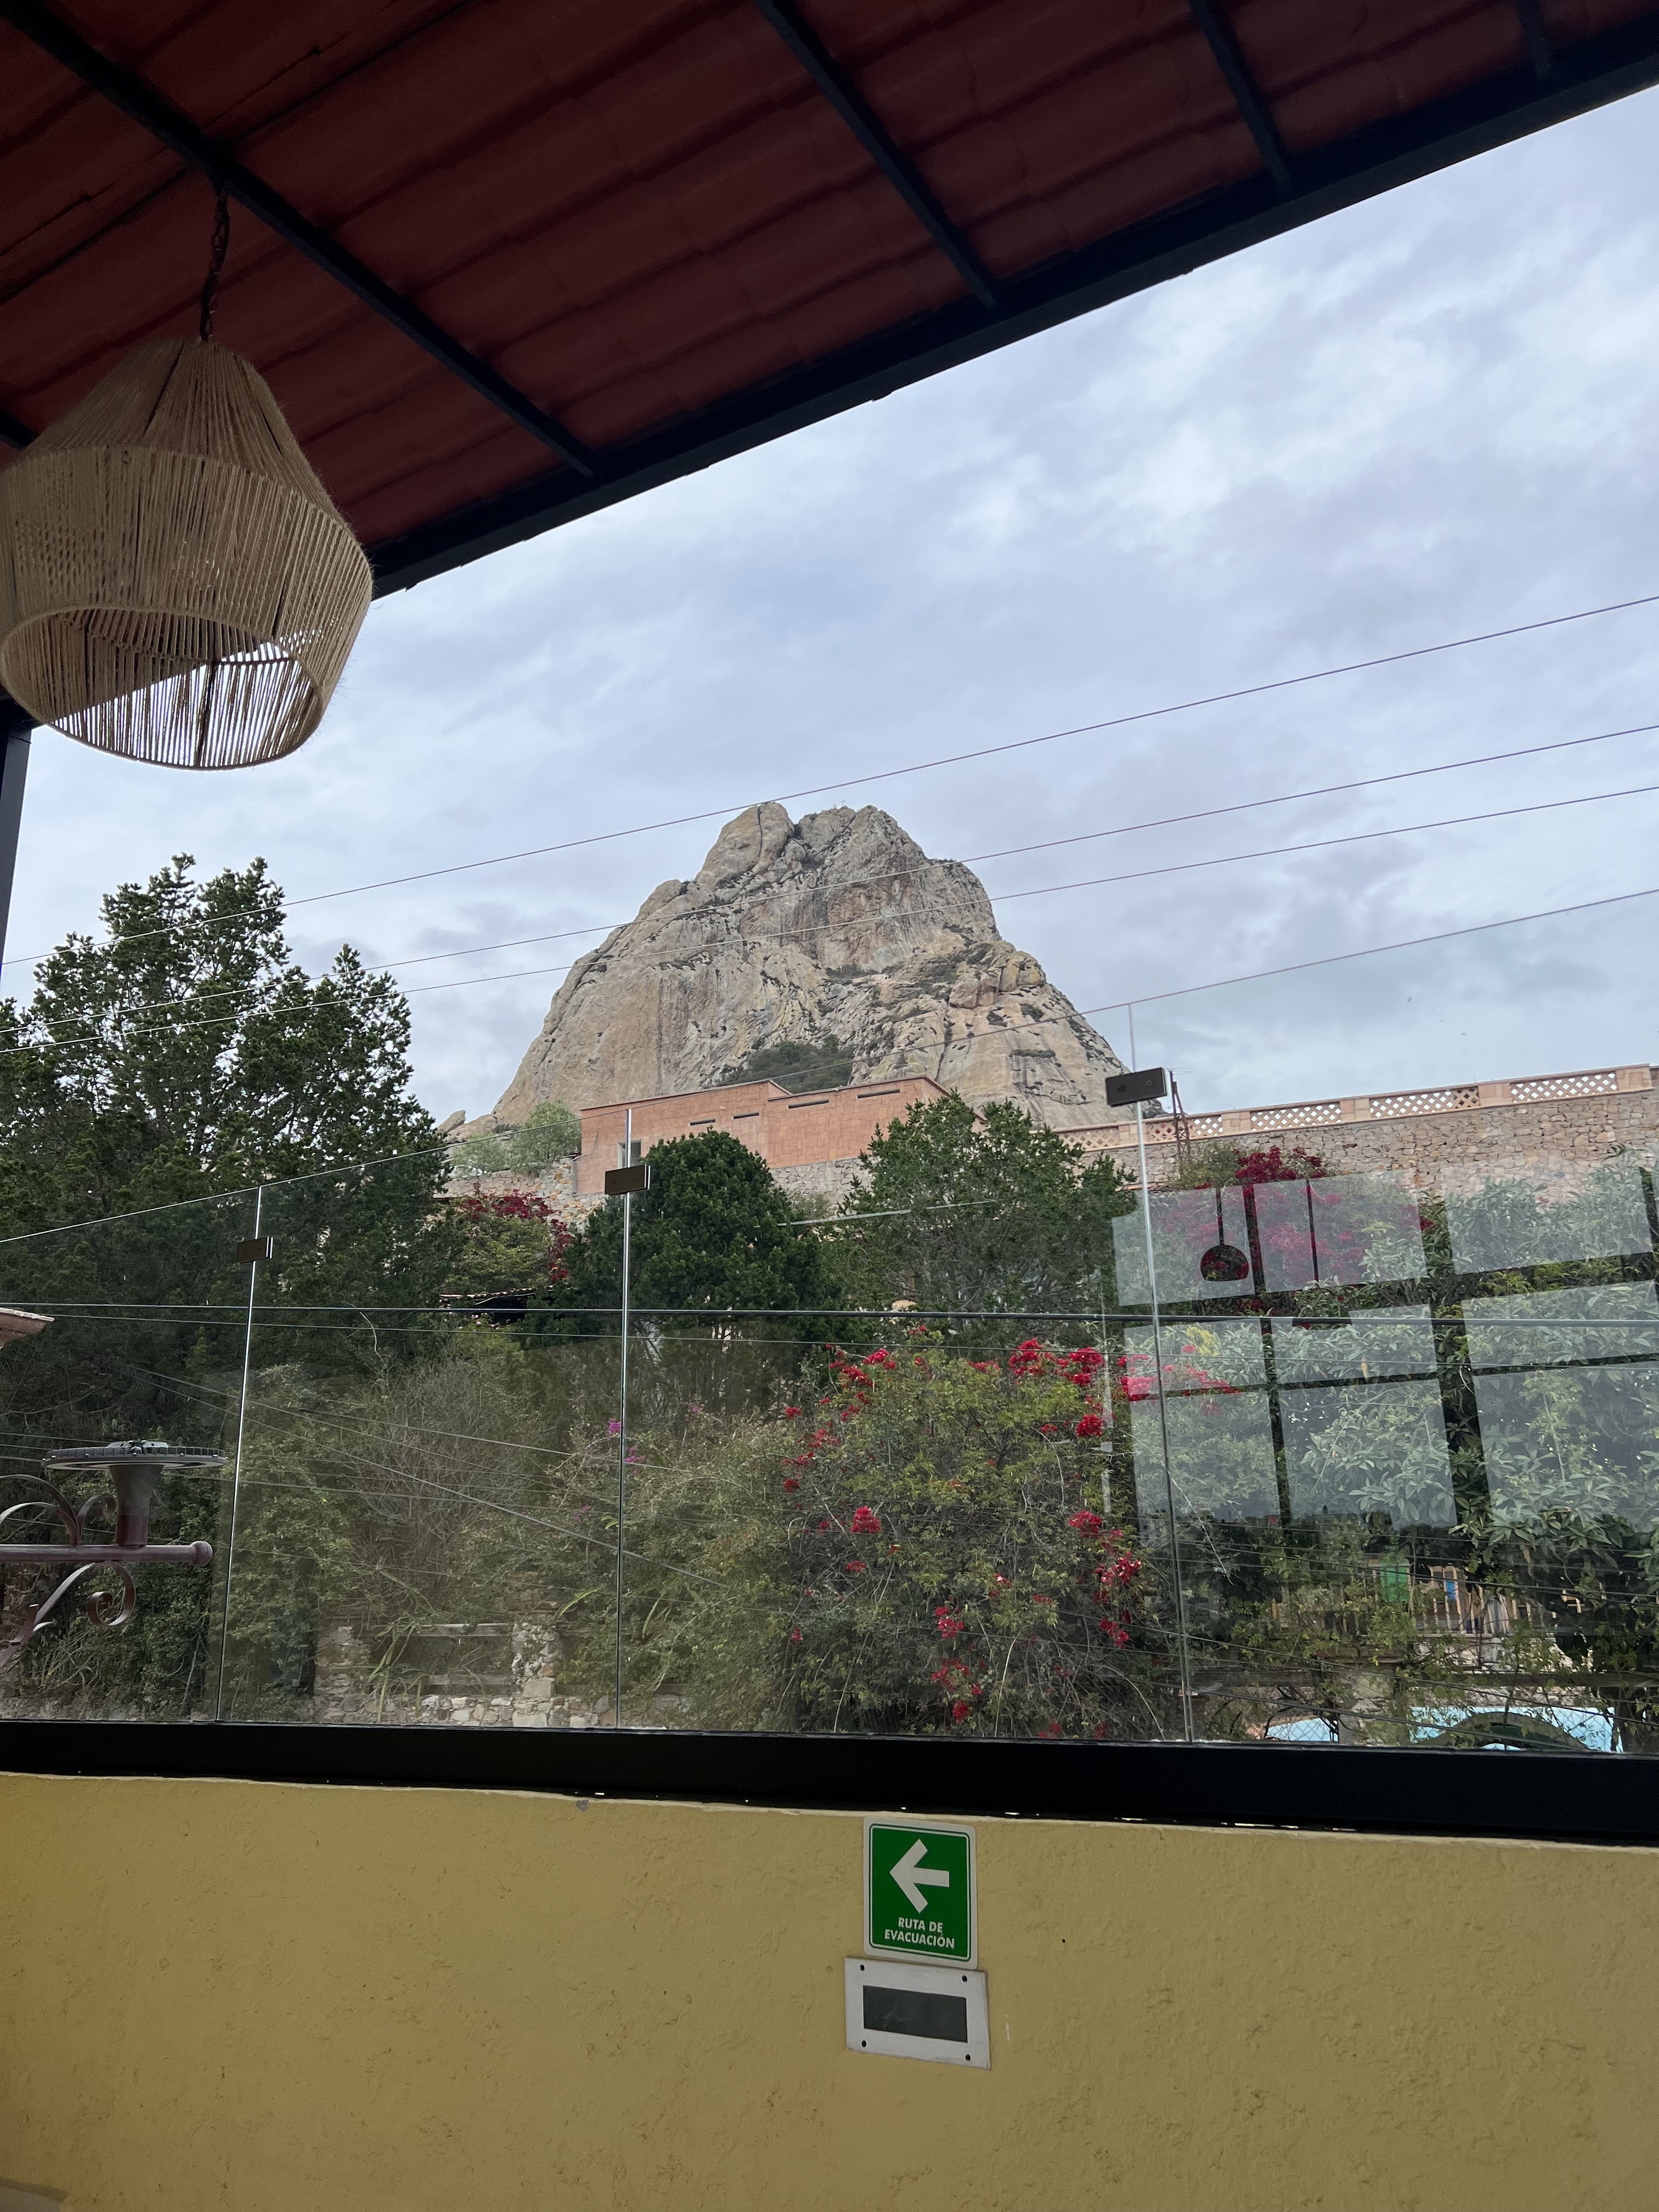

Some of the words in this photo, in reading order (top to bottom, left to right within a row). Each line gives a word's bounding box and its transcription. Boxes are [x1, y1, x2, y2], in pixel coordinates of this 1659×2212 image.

[898, 1917, 926, 1931] RUTA
[929, 1921, 944, 1933] DE
[884, 1928, 955, 1949] EVACUACIÓN
